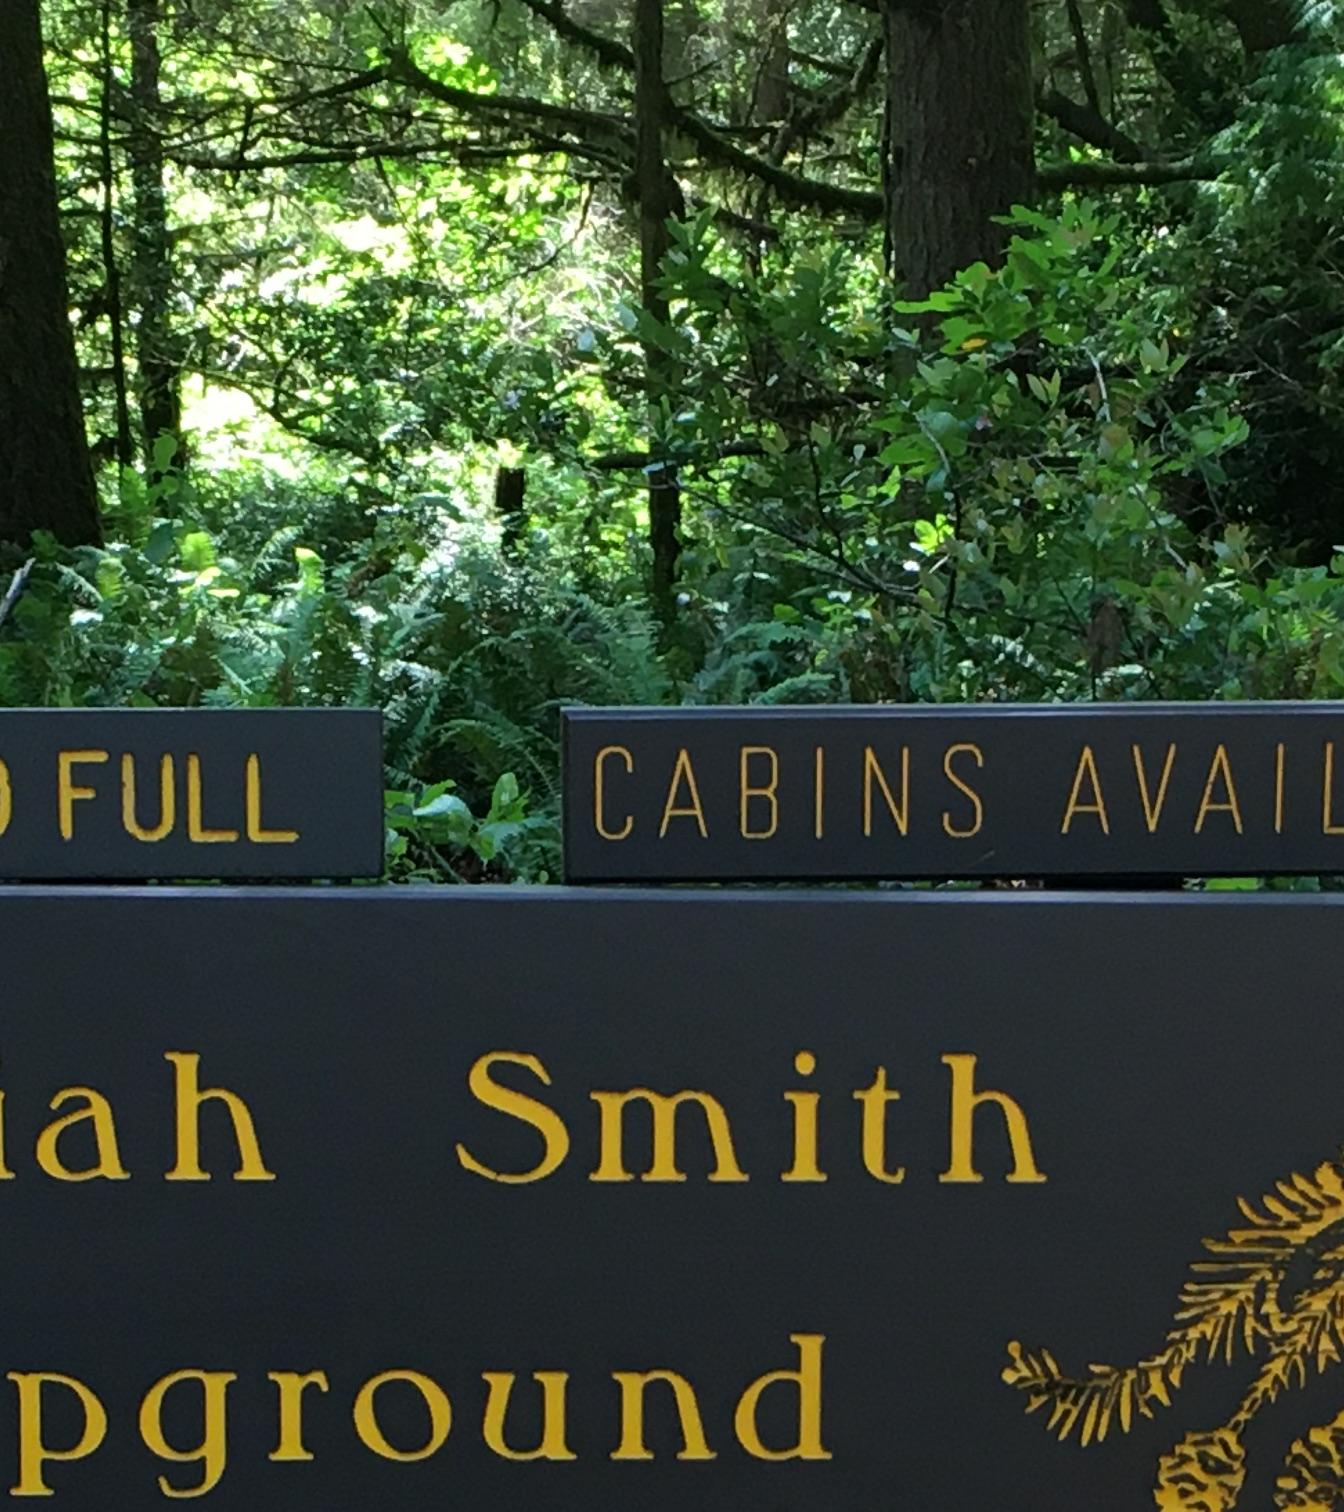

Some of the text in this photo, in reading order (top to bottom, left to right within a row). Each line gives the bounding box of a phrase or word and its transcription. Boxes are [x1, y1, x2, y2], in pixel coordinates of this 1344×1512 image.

[57, 748, 299, 843] FULL
[594, 743, 984, 840] CABINS
[454, 1050, 1048, 1185] Smith
